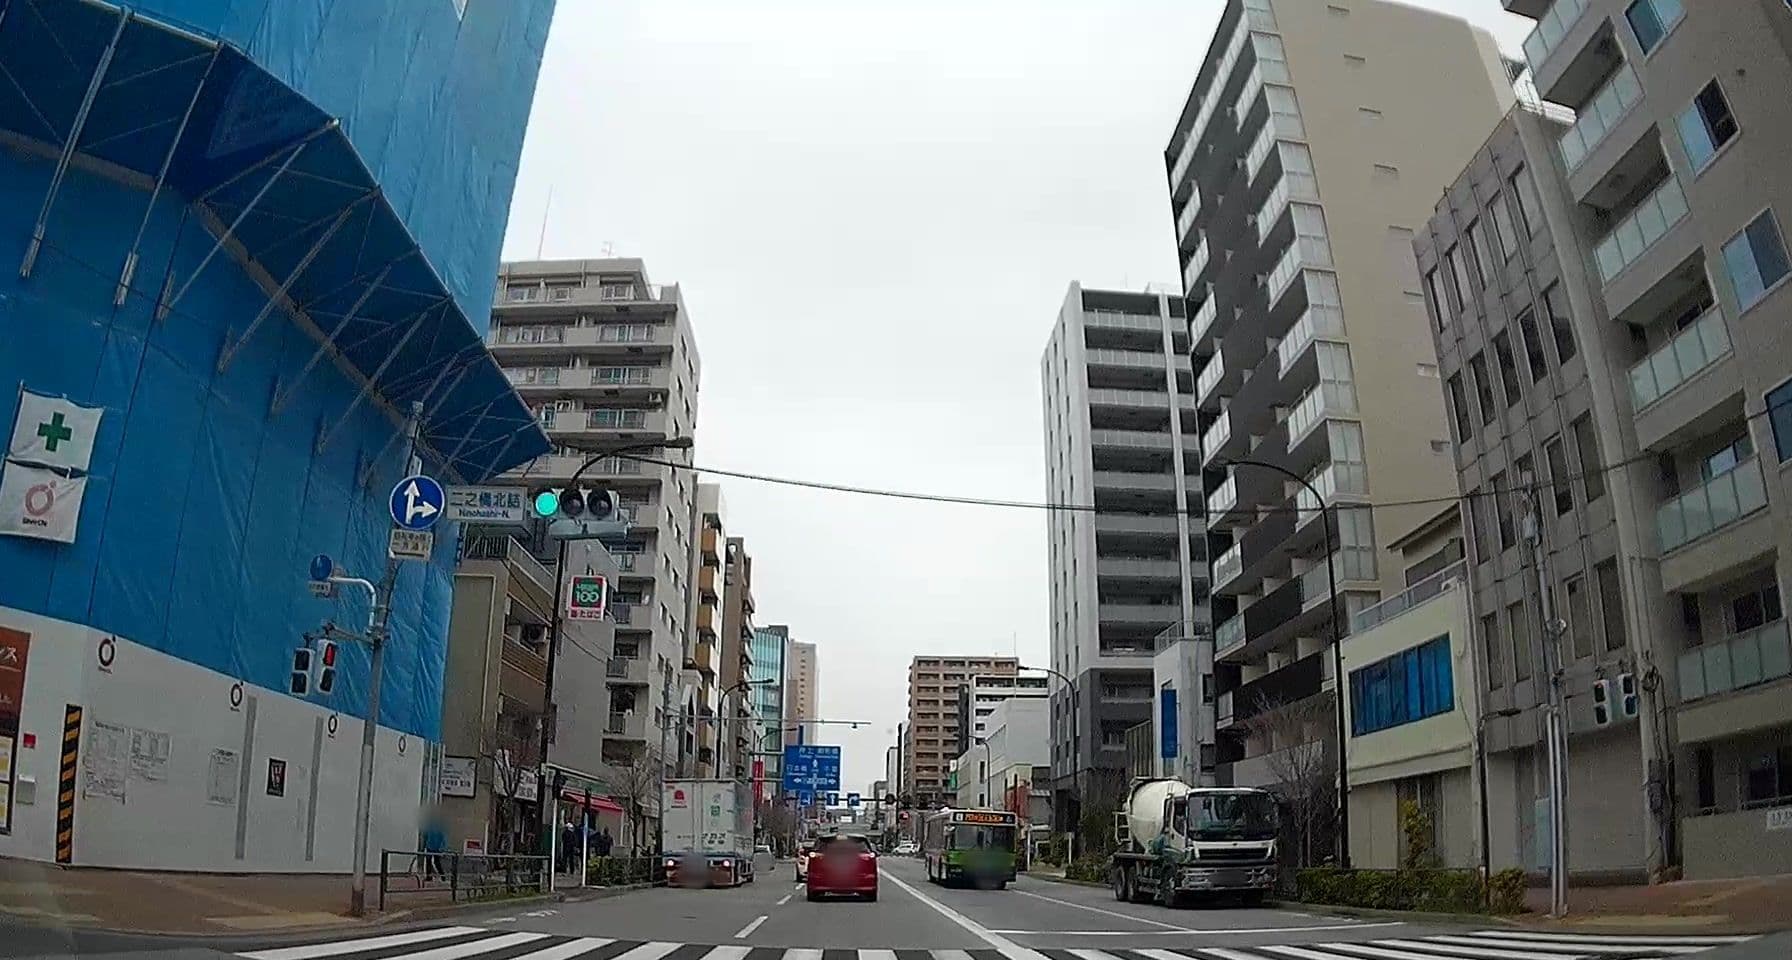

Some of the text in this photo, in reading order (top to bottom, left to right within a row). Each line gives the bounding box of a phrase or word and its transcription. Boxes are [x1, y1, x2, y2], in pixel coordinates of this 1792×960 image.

[450, 491, 520, 508] 二之橋北詰
[575, 591, 600, 603] 100
